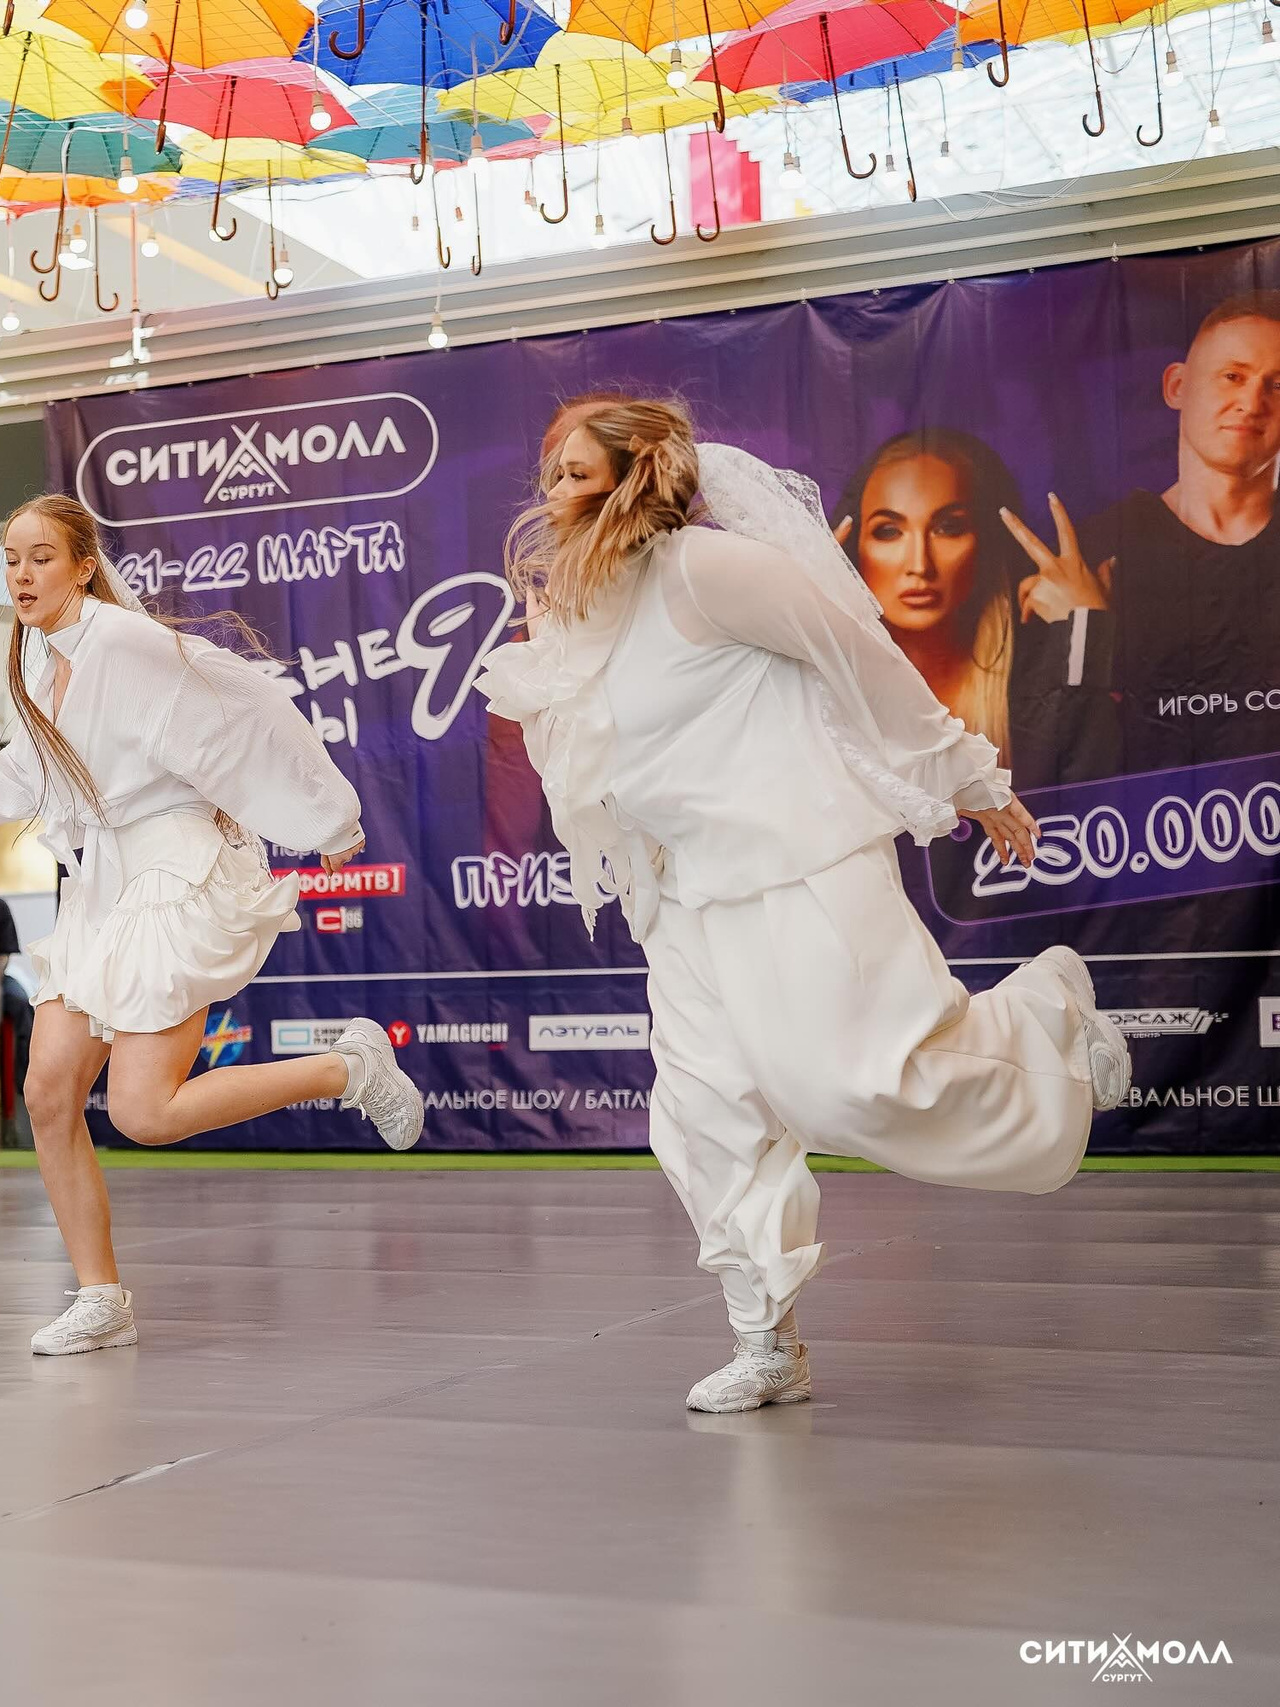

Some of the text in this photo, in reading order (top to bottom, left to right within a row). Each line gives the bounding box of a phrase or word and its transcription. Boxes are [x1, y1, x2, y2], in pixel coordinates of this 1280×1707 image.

[105, 416, 407, 486] СИТИ МОЛЛ
[217, 481, 276, 502] СУРГУТ
[117, 520, 406, 596] 21-22 МАРТА
[1158, 692, 1238, 717] ИГОРЬ
[416, 1023, 509, 1044] YAMAGUCHI
[422, 1088, 507, 1110] АЛЬНОЕ
[512, 1088, 565, 1110] ШОУ
[585, 1088, 650, 1110] БАТТЛ
